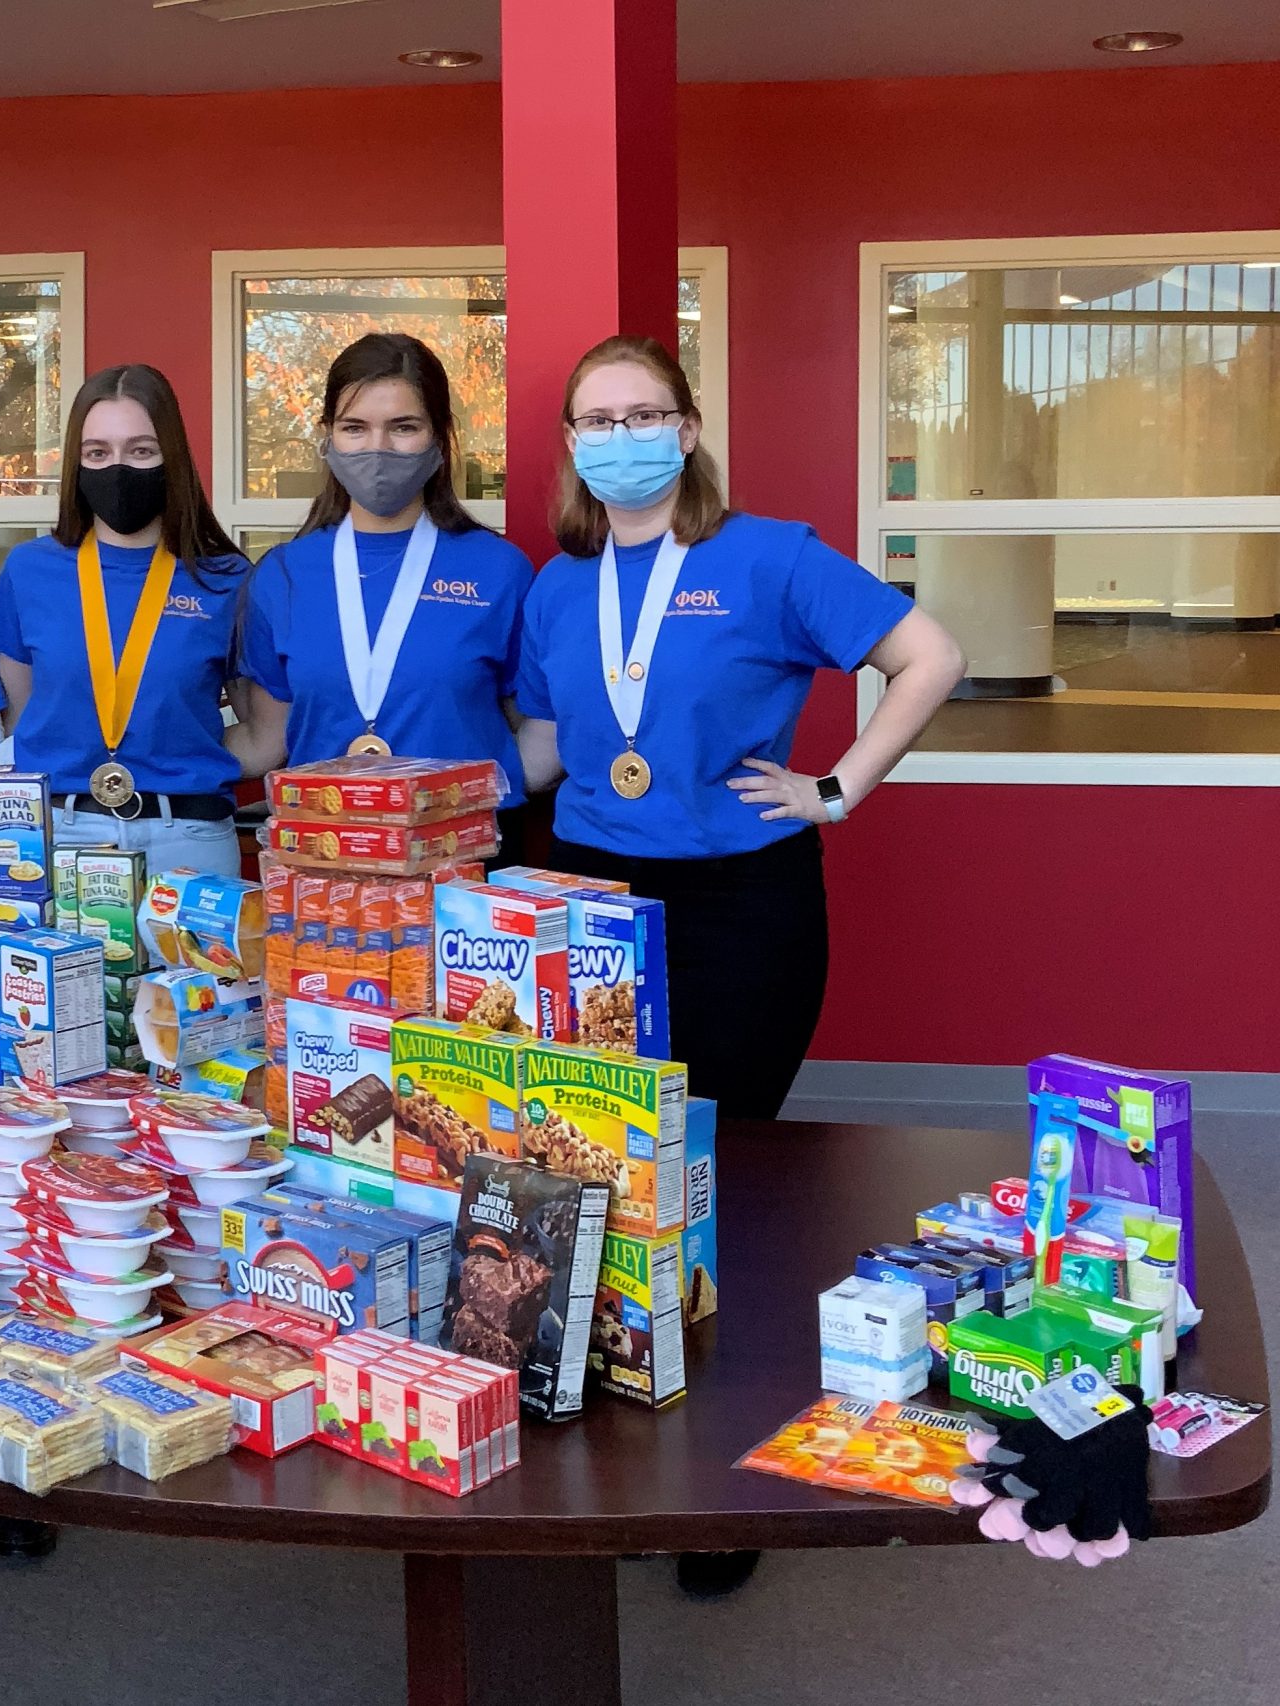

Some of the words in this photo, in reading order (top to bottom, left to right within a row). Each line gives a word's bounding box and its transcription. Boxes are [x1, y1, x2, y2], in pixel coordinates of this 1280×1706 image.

[59, 881, 75, 892] TUN
[88, 875, 101, 885] FAT
[103, 874, 120, 886] FREE
[82, 887, 102, 898] TUNA
[103, 888, 128, 899] SALAD
[441, 931, 529, 980] Chewy
[569, 946, 624, 988] ewy
[5, 973, 46, 992] toaster
[5, 986, 46, 1005] pastries
[539, 986, 556, 1040] Chewy
[295, 1031, 333, 1051] Chewy
[301, 1048, 358, 1075] Dipped
[394, 1031, 453, 1061] NATURE
[453, 1042, 510, 1083] VALLEY
[420, 1064, 484, 1092] Protein
[527, 1053, 591, 1084] NATURE
[591, 1064, 651, 1107] VALLEY
[553, 1088, 622, 1117] Protein
[628, 1139, 654, 1150] ROASTED
[689, 1165, 699, 1220] GRAIN
[698, 1161, 708, 1217] NUTRI
[477, 1191, 515, 1213] DOUBLE
[468, 1203, 520, 1230] CHOCOLATE
[606, 1238, 643, 1280] LLEY
[612, 1274, 638, 1295] nut
[821, 1315, 858, 1335] IVORY
[954, 1349, 1041, 1402] Spring
[835, 1400, 870, 1417] HOTH
[896, 1407, 967, 1431] HOTHAND
[873, 1418, 913, 1433] HAND
[915, 1427, 966, 1443] WARME
[922, 1477, 947, 1493] 10
